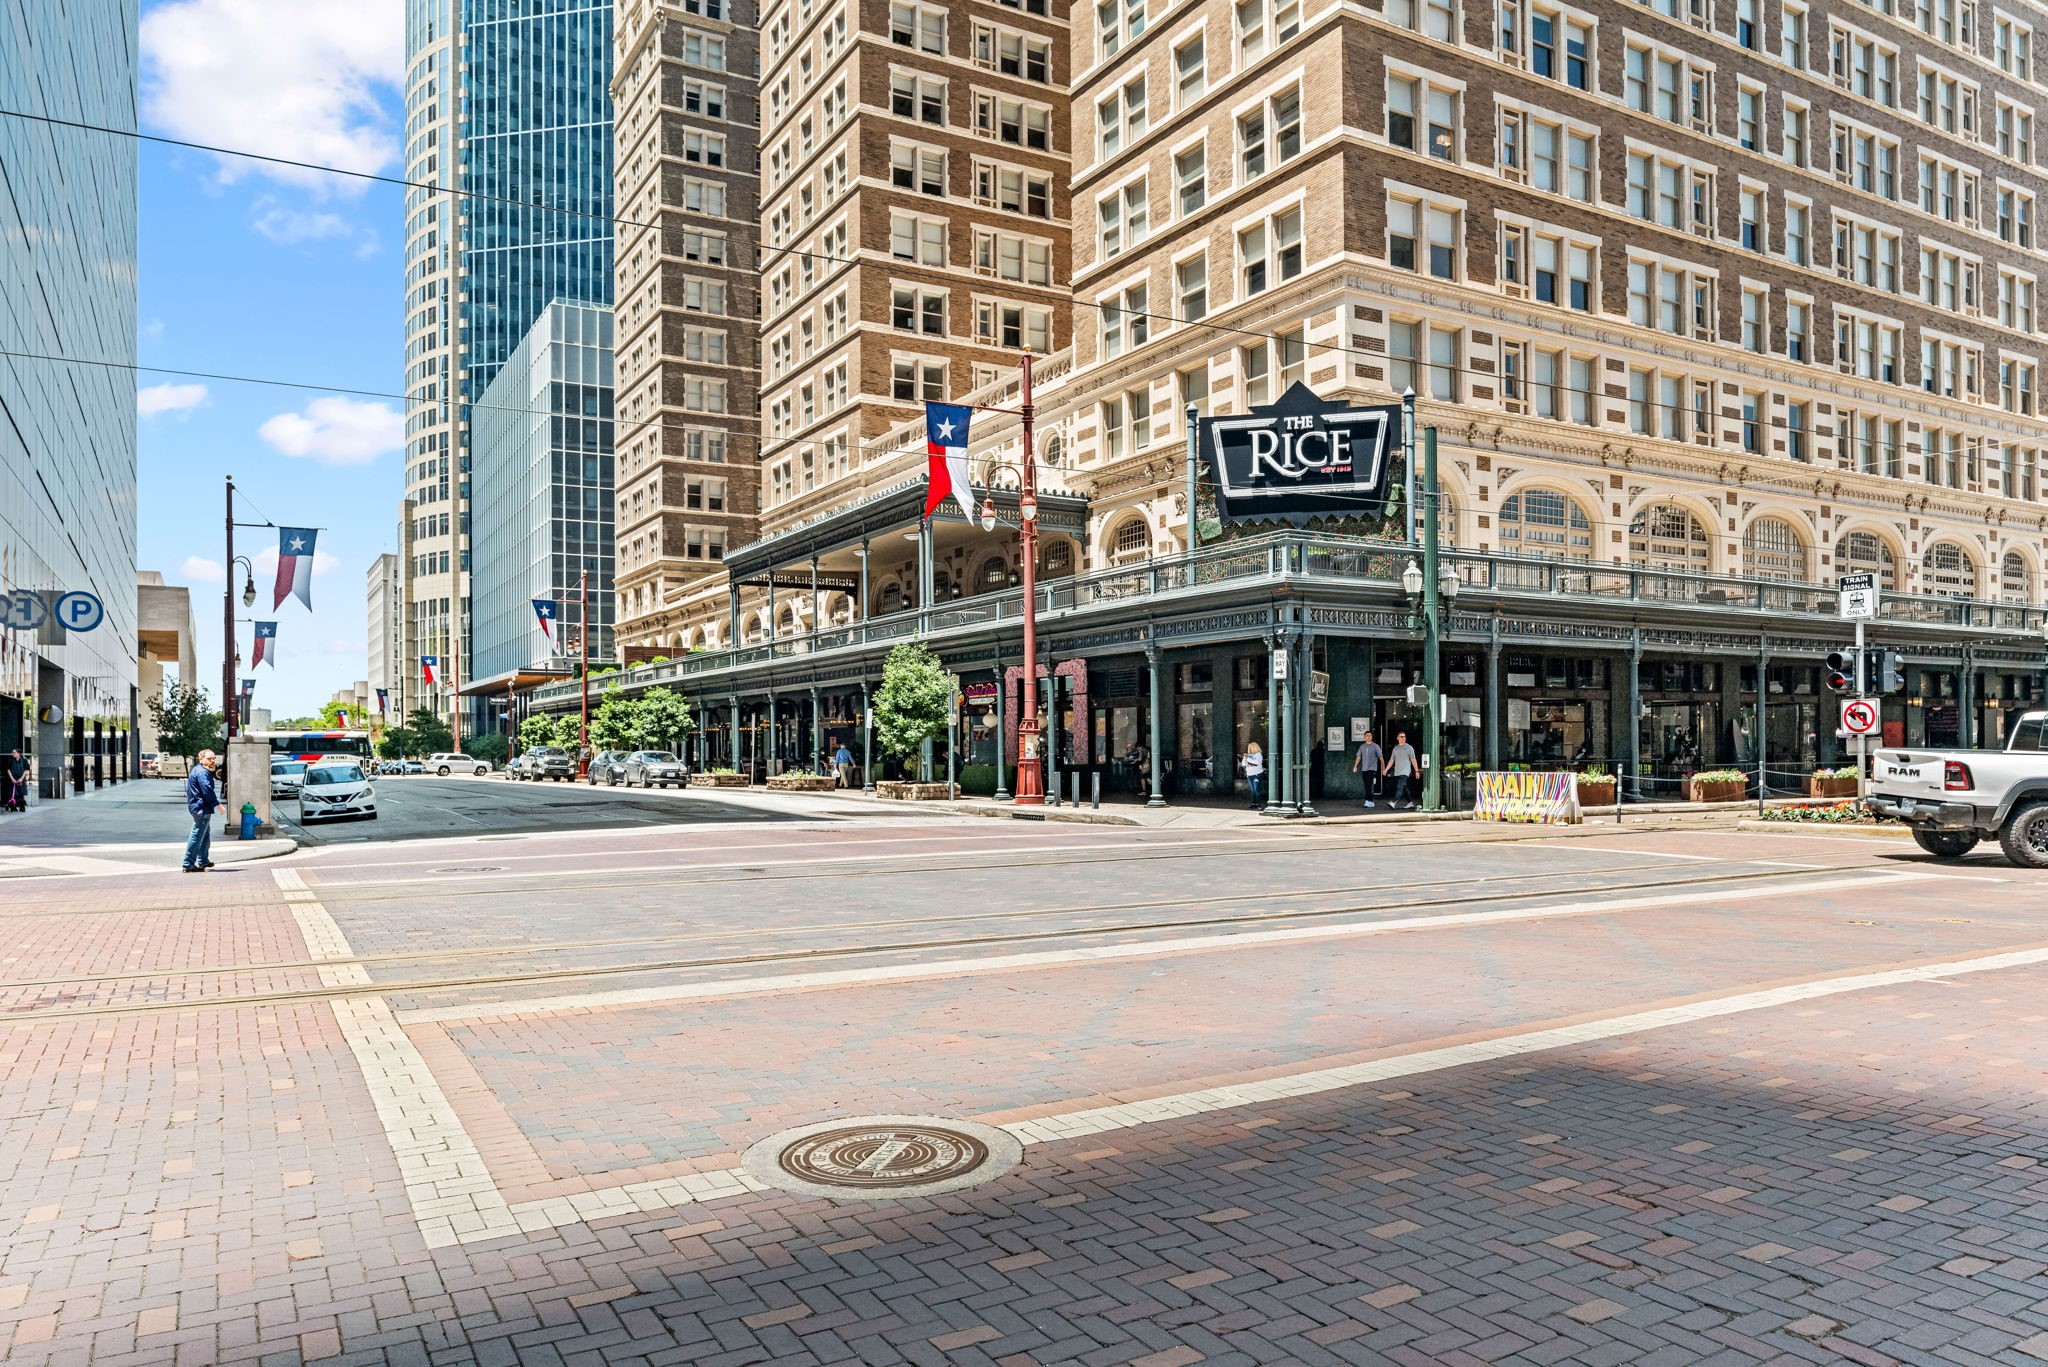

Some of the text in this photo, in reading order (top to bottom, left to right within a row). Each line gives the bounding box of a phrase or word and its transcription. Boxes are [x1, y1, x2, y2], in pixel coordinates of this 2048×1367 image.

[1284, 415, 1313, 430] THE
[1247, 429, 1352, 478] RICE
[1845, 576, 1868, 584] TRAIN
[1843, 583, 1870, 592] SIGNAL
[71, 600, 92, 623] P
[1846, 608, 1867, 616] ONLY
[1275, 652, 1285, 660] ONE
[1888, 766, 1921, 778] RAM
[1483, 772, 1546, 799] MAIN
